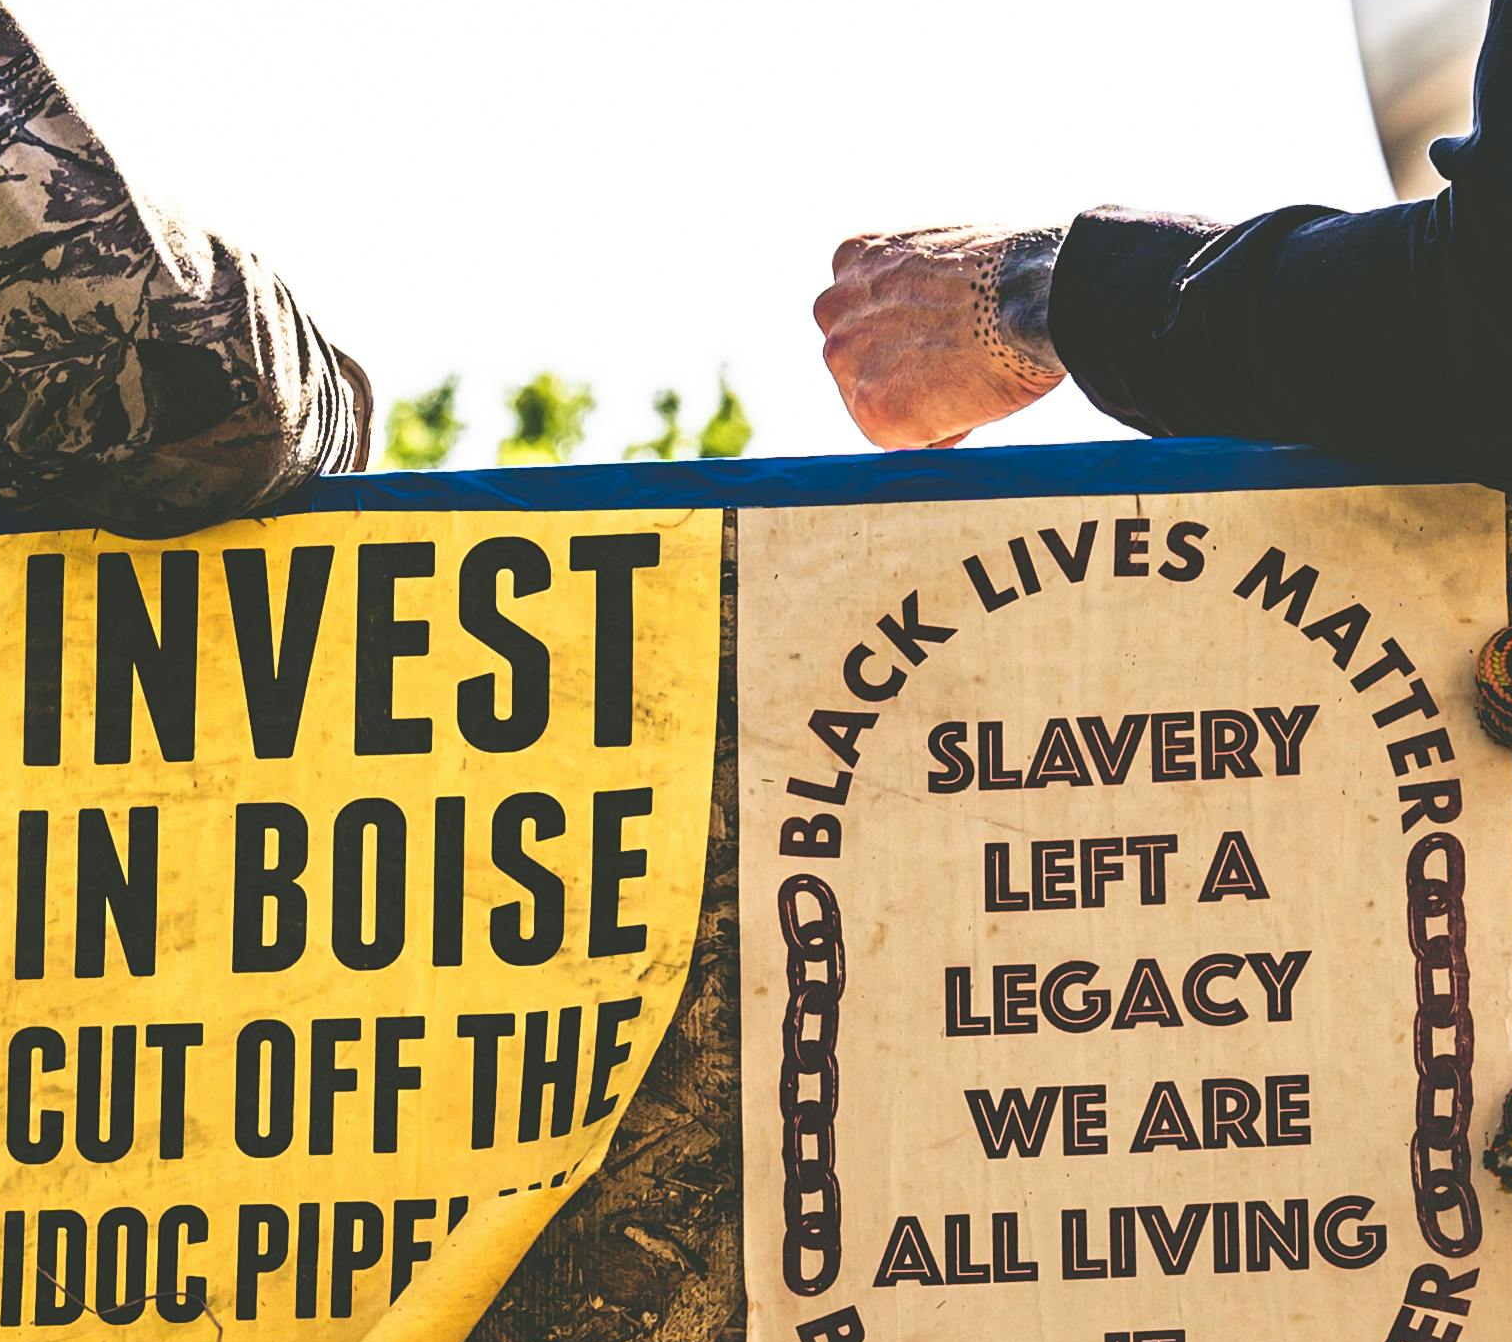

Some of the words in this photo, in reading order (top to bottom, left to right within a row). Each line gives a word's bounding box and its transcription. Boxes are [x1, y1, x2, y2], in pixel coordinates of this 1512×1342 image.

[24, 533, 660, 766] INVEST
[779, 590, 957, 858] BLACK
[963, 519, 1209, 612] LIVES
[1233, 547, 1462, 834] MATTER
[928, 705, 1320, 793] SLAVERY
[15, 806, 158, 980] IN
[232, 787, 652, 973] BOISE
[985, 834, 1177, 912] LEFT
[1198, 831, 1270, 902] A
[945, 951, 1312, 1037] LEGACY
[7, 1023, 203, 1164] CUT
[235, 1016, 425, 1158] OFF
[457, 997, 642, 1149] THE
[964, 1085, 1107, 1159] WE
[1130, 1075, 1311, 1153] ARE
[0, 1205, 208, 1326] IDOC
[873, 1212, 1038, 1287] ALL
[1062, 1196, 1387, 1280] LIVING
